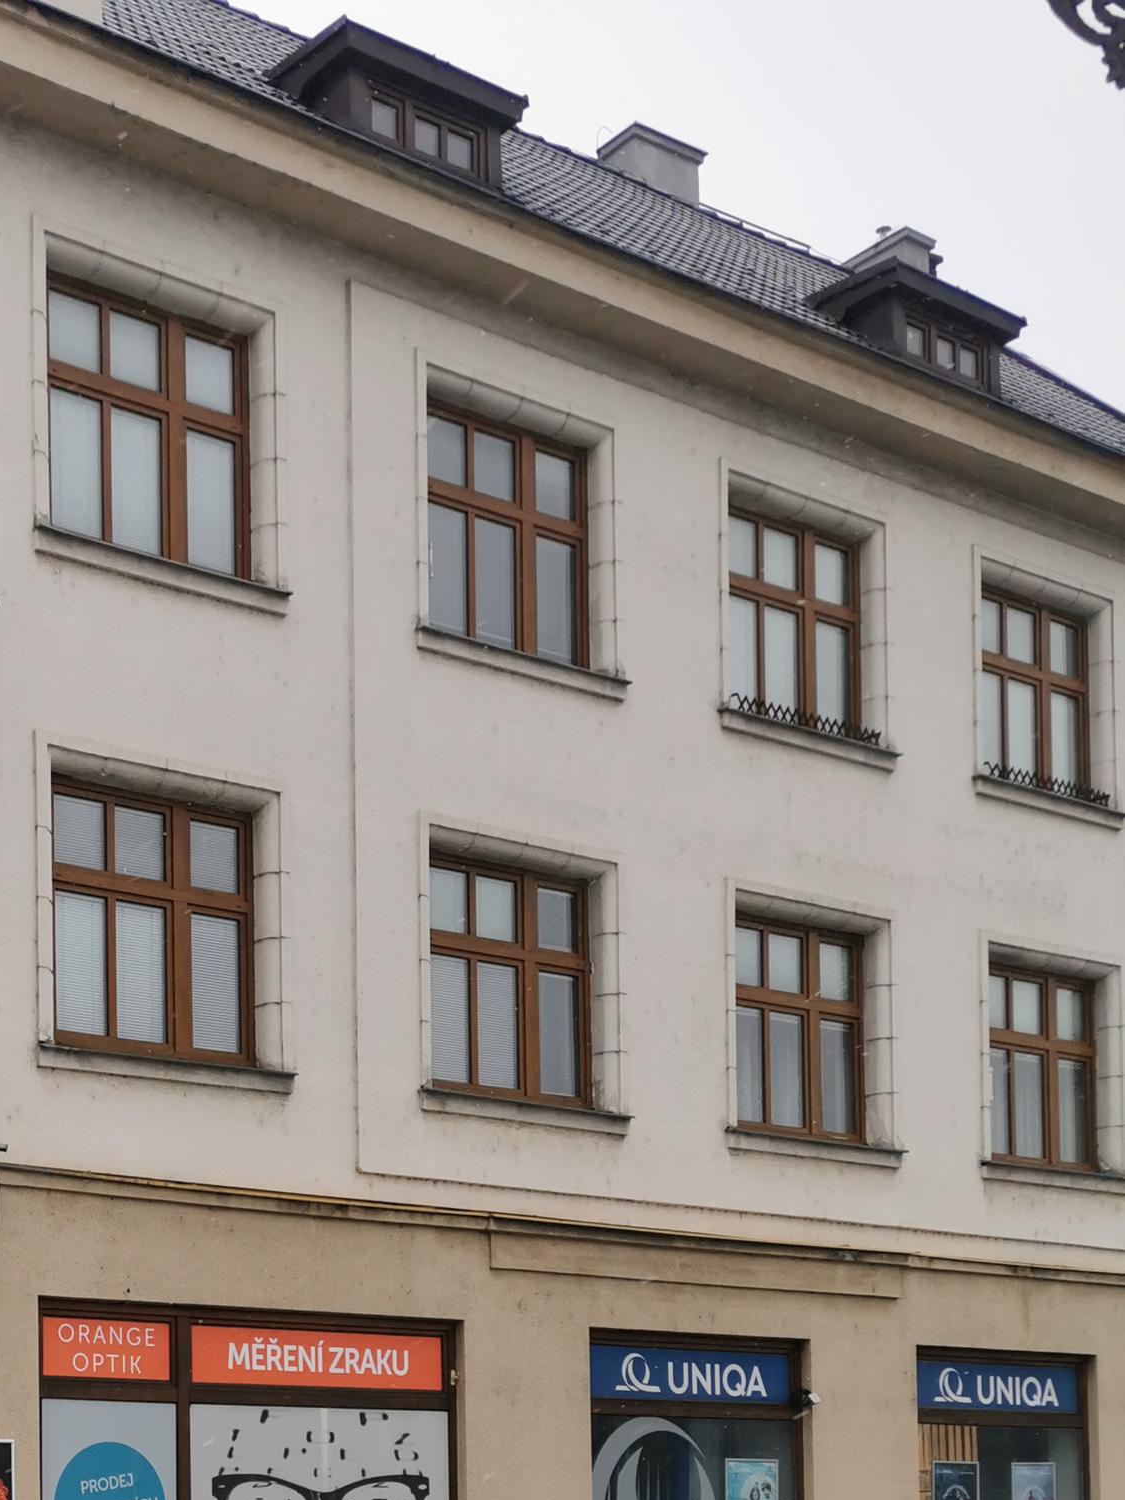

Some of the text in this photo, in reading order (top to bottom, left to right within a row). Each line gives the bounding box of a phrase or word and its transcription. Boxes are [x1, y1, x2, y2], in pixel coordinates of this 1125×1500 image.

[58, 1323, 155, 1347] ORANGE
[72, 1352, 142, 1375] OPTIK
[227, 1337, 410, 1377] MĚŘENÍ ZRAKU
[667, 1361, 768, 1398] UNIQA
[976, 1374, 1060, 1407] UNIQA
[80, 1472, 134, 1495] PRODEJ
